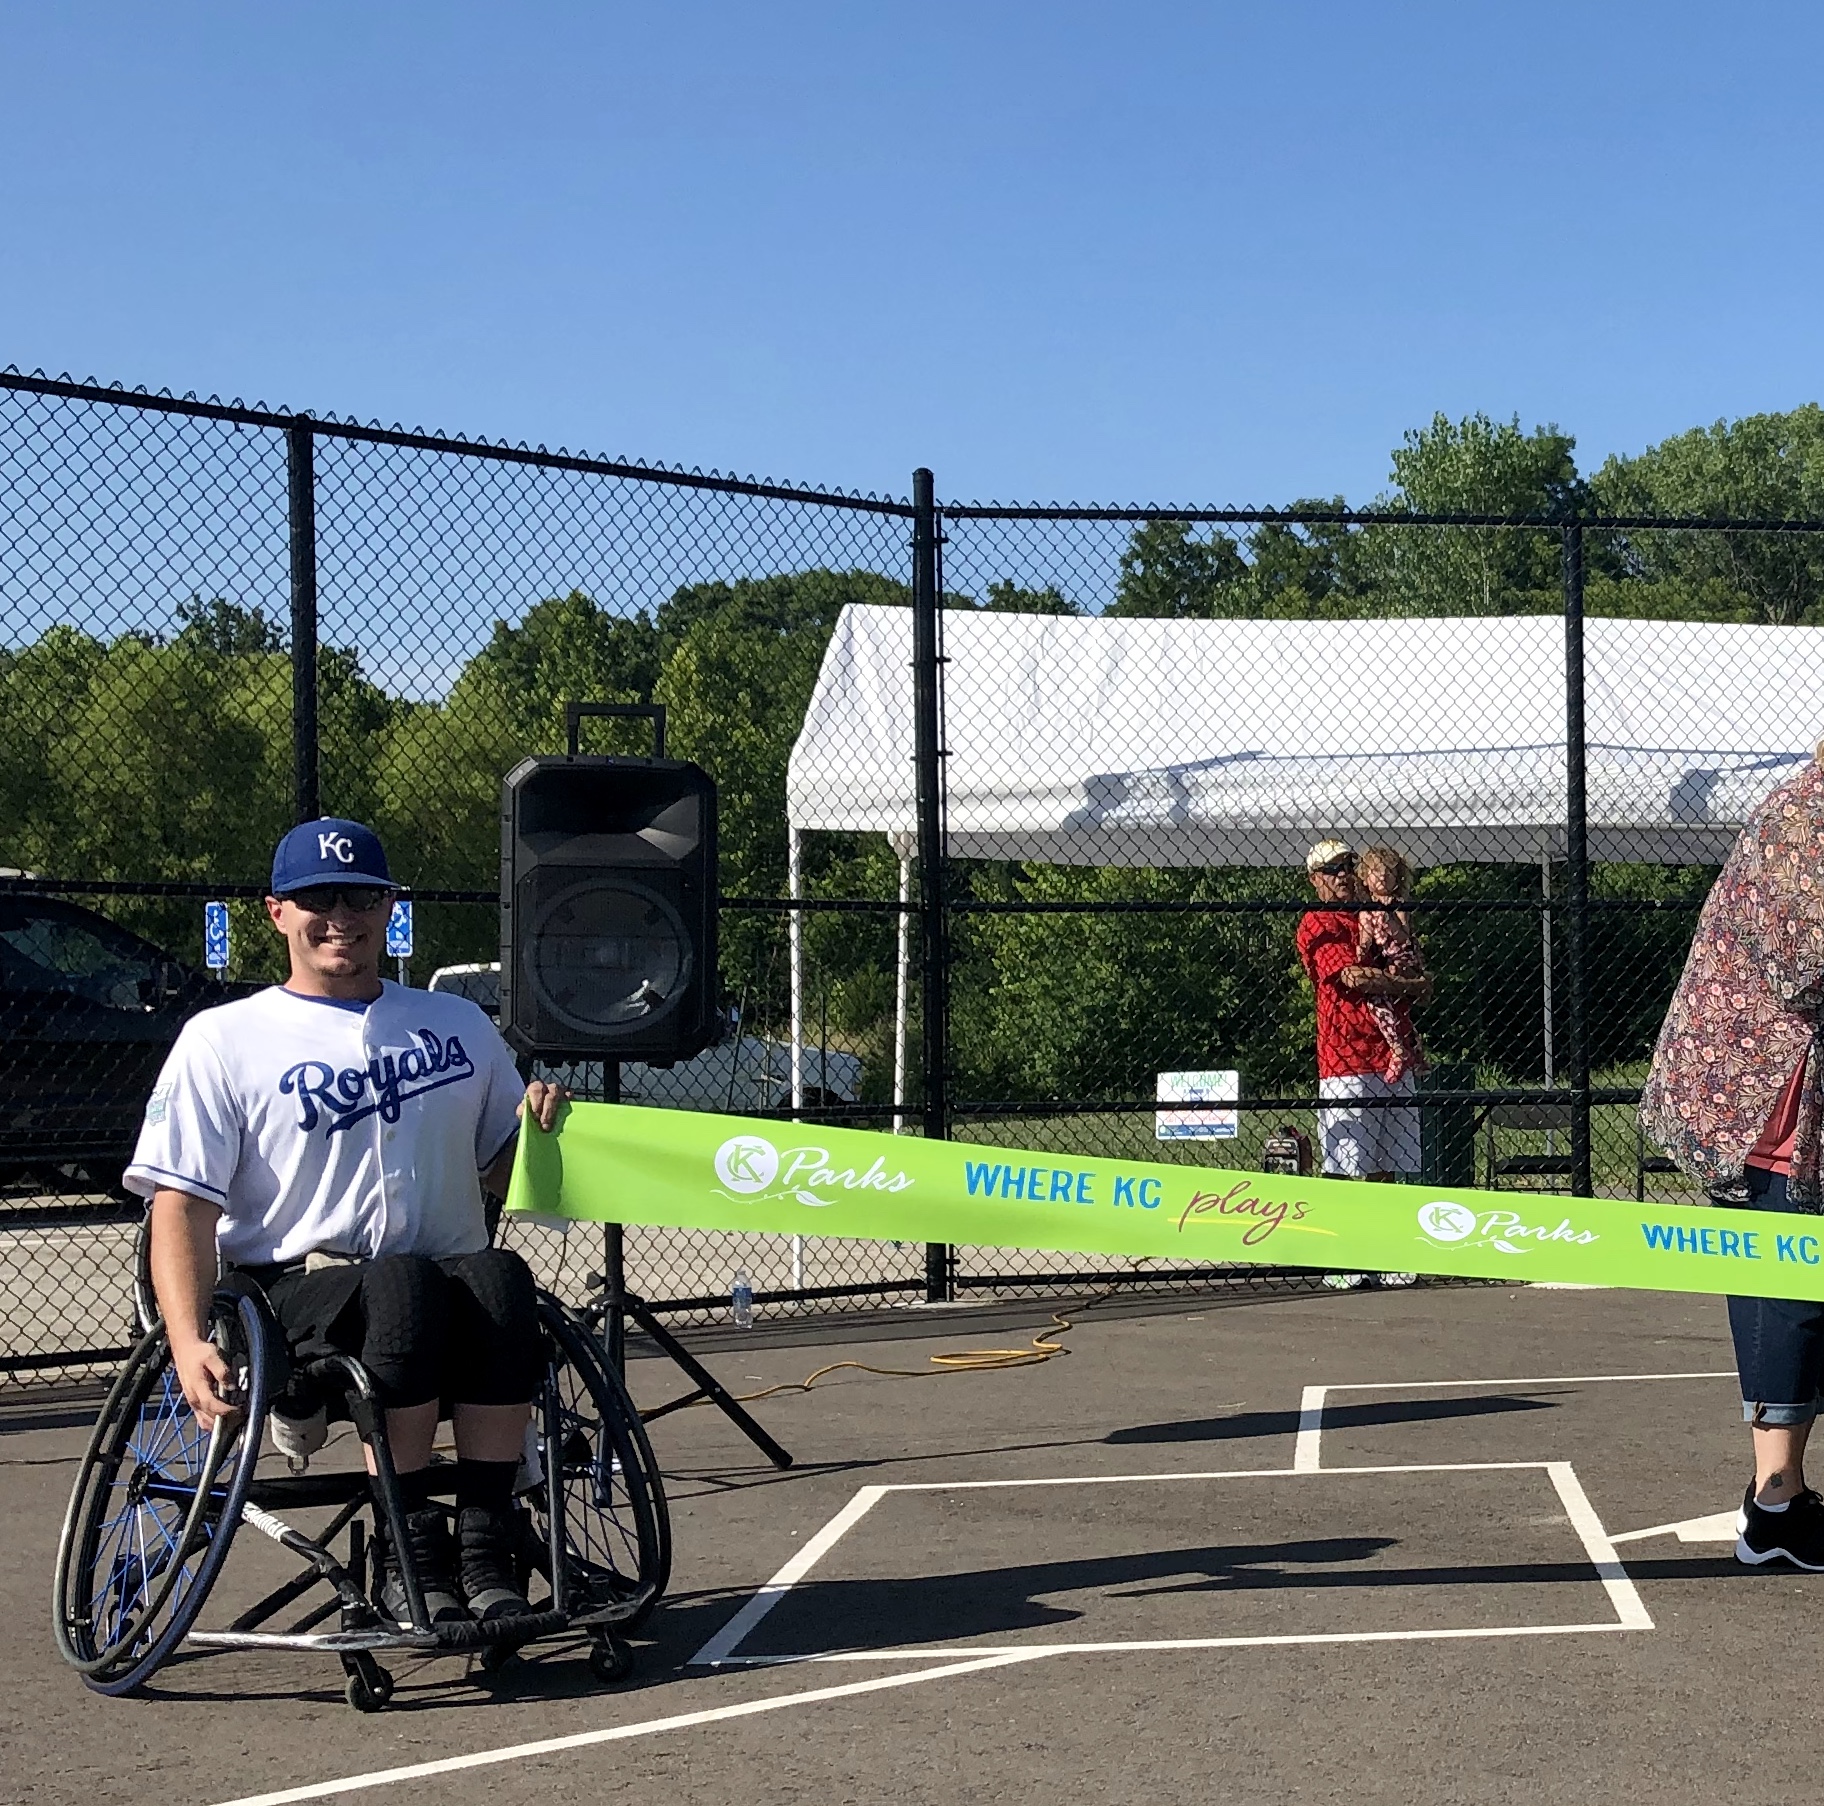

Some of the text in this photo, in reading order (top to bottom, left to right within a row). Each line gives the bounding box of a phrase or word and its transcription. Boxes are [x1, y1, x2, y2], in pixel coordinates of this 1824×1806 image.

[318, 831, 354, 864] KC
[279, 1028, 475, 1139] Royals
[780, 1146, 916, 1193] Parks
[966, 1161, 1317, 1246] WHERE KC plays
[1476, 1210, 1601, 1245] Parks
[1641, 1222, 1760, 1259] WHERE
[1777, 1235, 1821, 1265] KC
